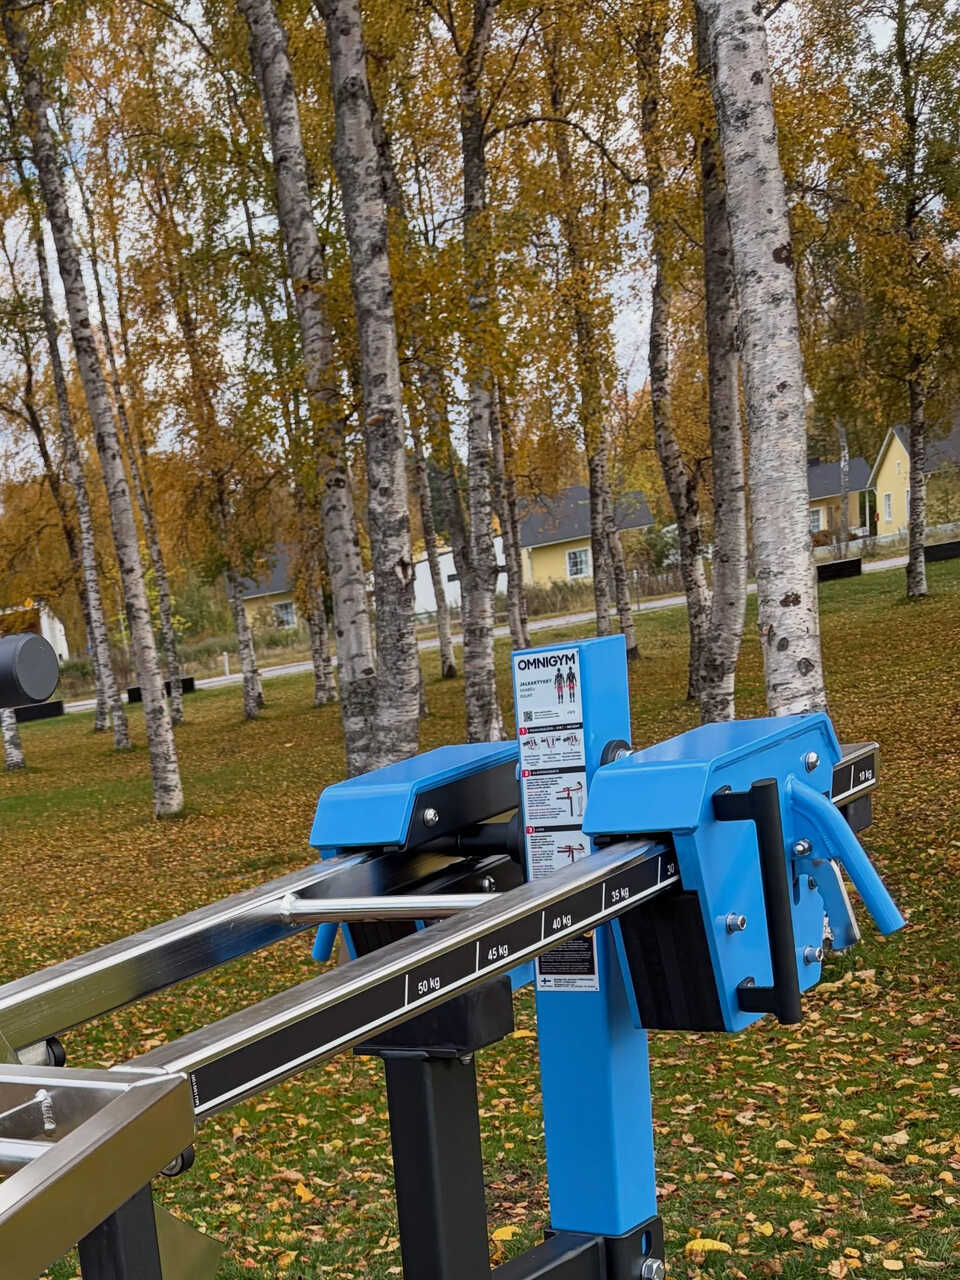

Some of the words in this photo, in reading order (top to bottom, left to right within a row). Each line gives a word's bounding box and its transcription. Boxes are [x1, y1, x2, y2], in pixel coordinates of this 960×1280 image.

[518, 653, 576, 671] OMNIGYM
[667, 863, 675, 876] 30
[611, 890, 620, 903] 35
[620, 886, 630, 899] kg
[552, 917, 562, 930] 40
[562, 914, 572, 927] kg
[487, 947, 498, 960] 45
[498, 944, 509, 957] kg
[418, 980, 429, 995] 50
[429, 976, 441, 989] kg
